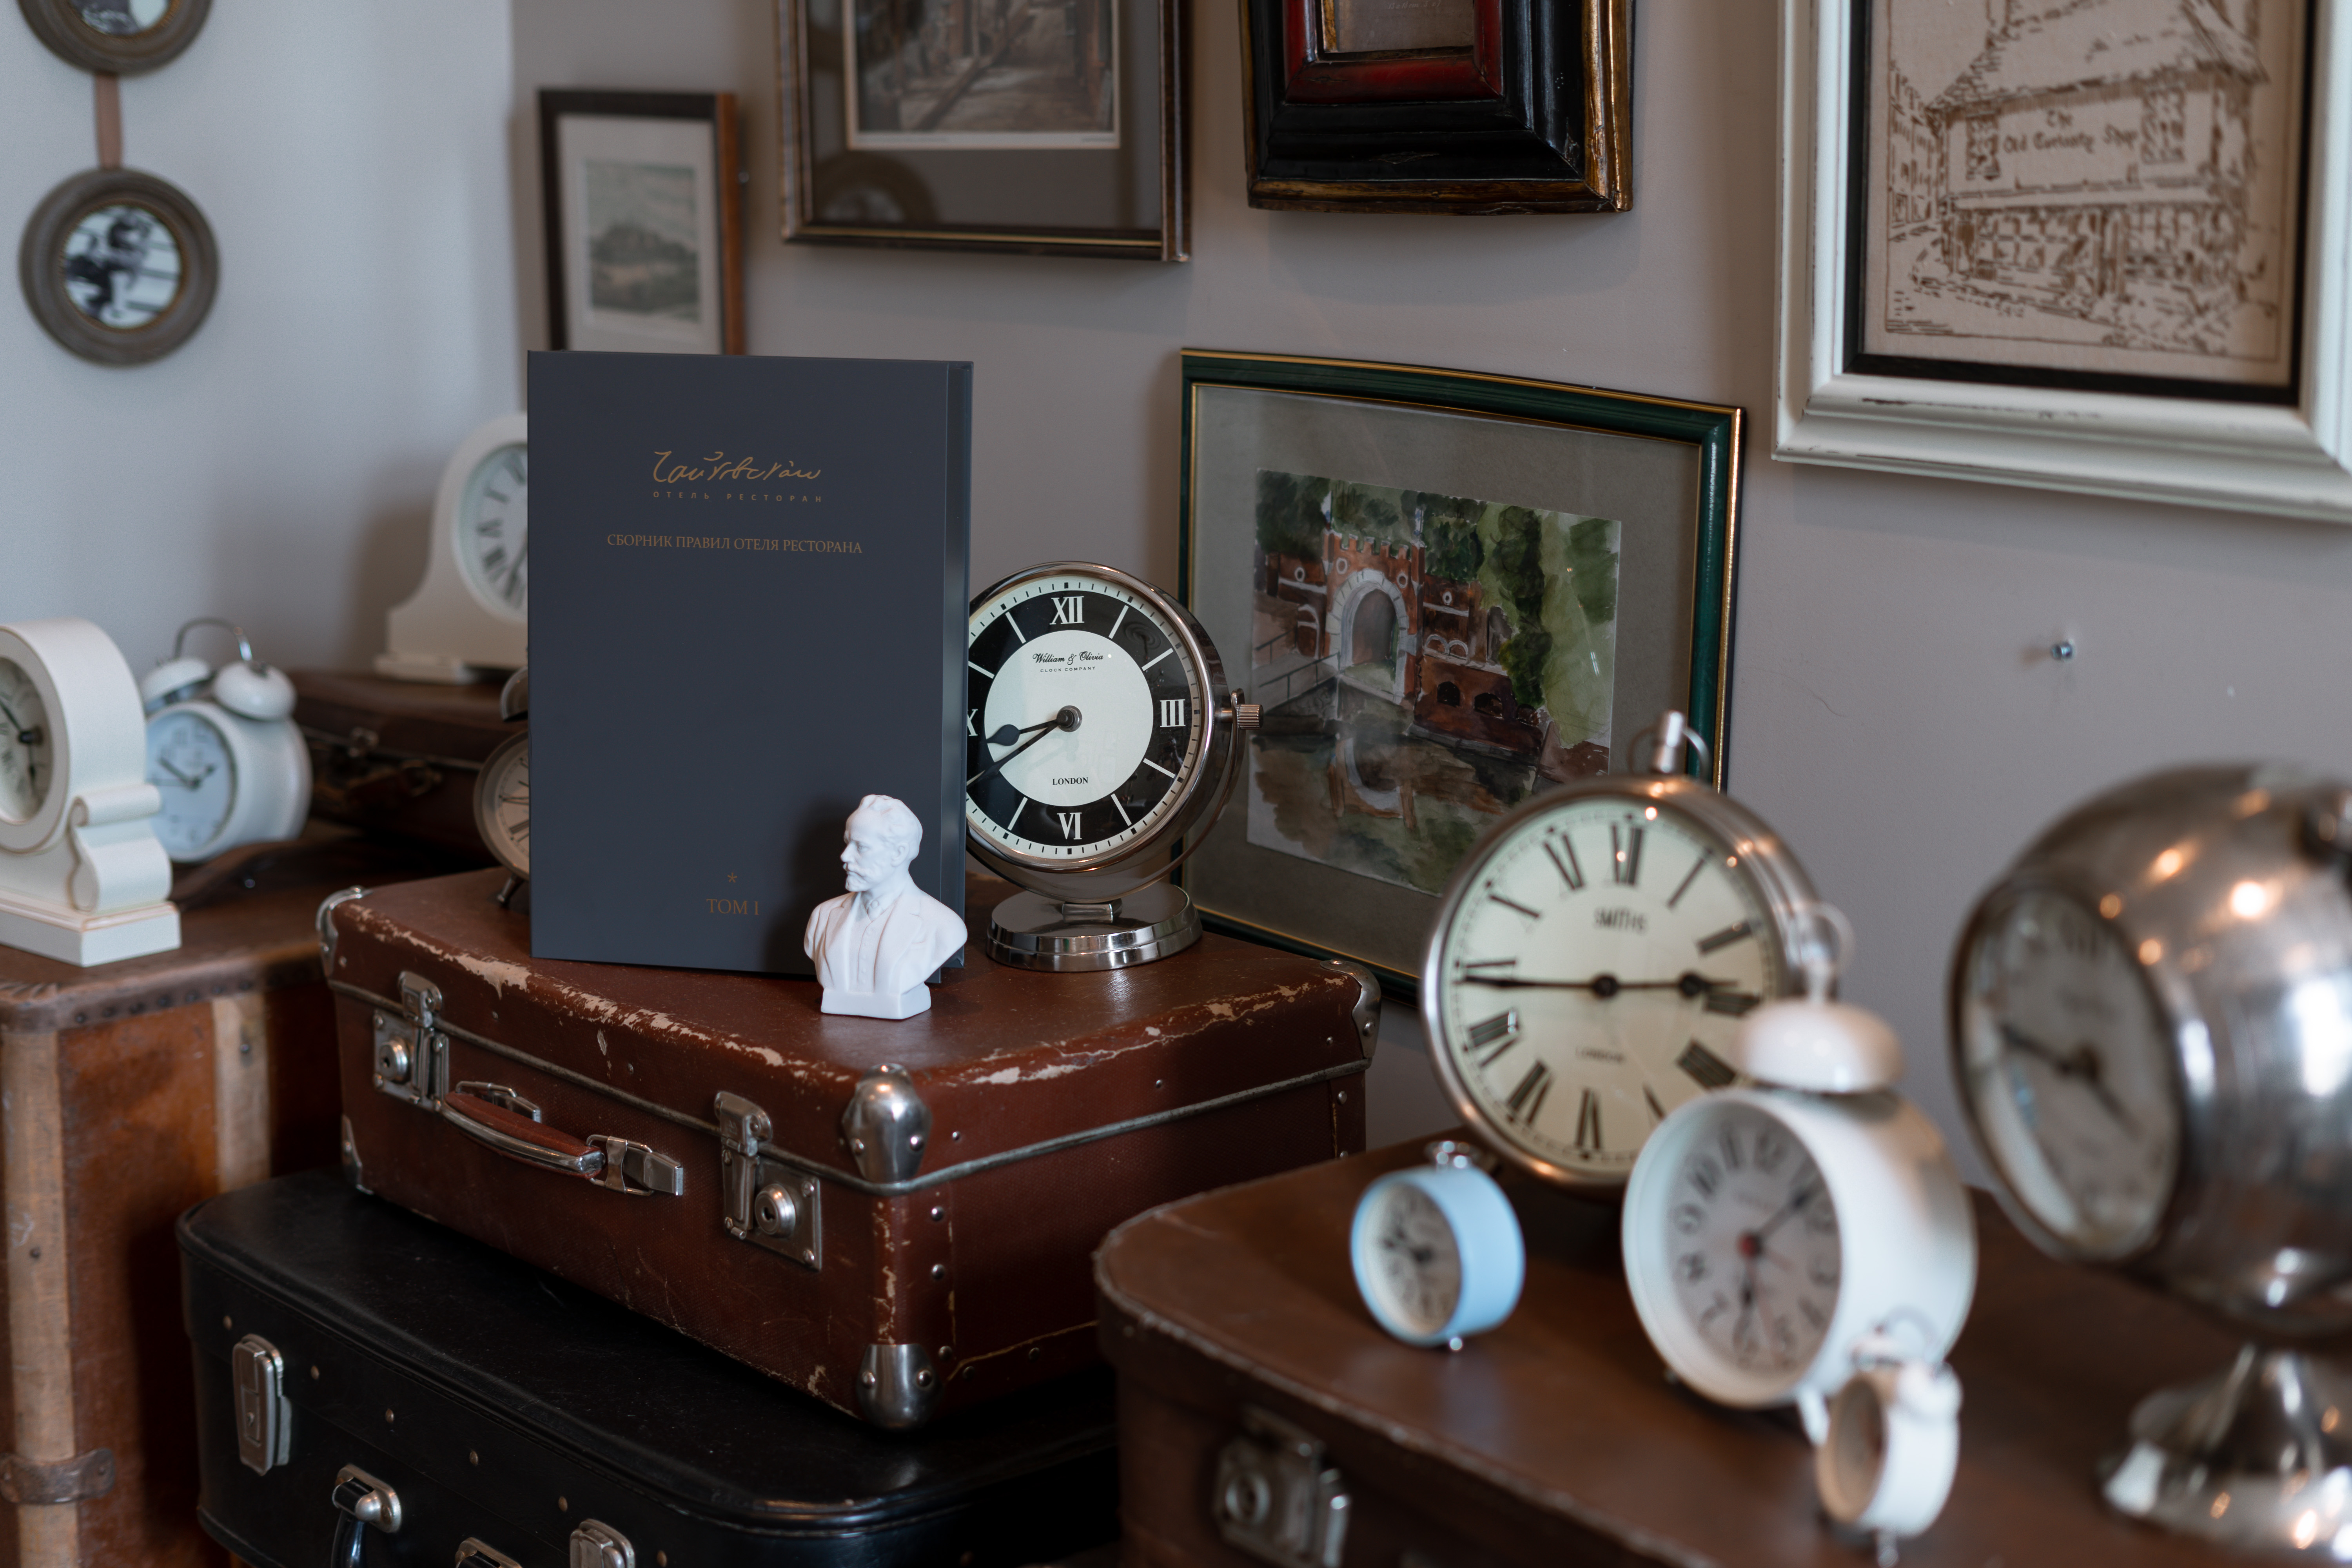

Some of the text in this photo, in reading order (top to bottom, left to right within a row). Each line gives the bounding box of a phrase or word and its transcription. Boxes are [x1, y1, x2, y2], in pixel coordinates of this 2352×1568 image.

[653, 491, 822, 503] ОТЕЛЬ РЕСТОРАН
[607, 534, 862, 554] СБОРНИК ПРАВИЛ ОТЕЛЯ РЕСТОРАНА
[1049, 595, 1085, 625] XII
[1032, 651, 1104, 665] William & Olivia
[1160, 699, 1186, 728] III
[1052, 777, 1089, 785] LONDON
[1057, 812, 1083, 840] VI
[706, 898, 759, 915] ТОМ I
